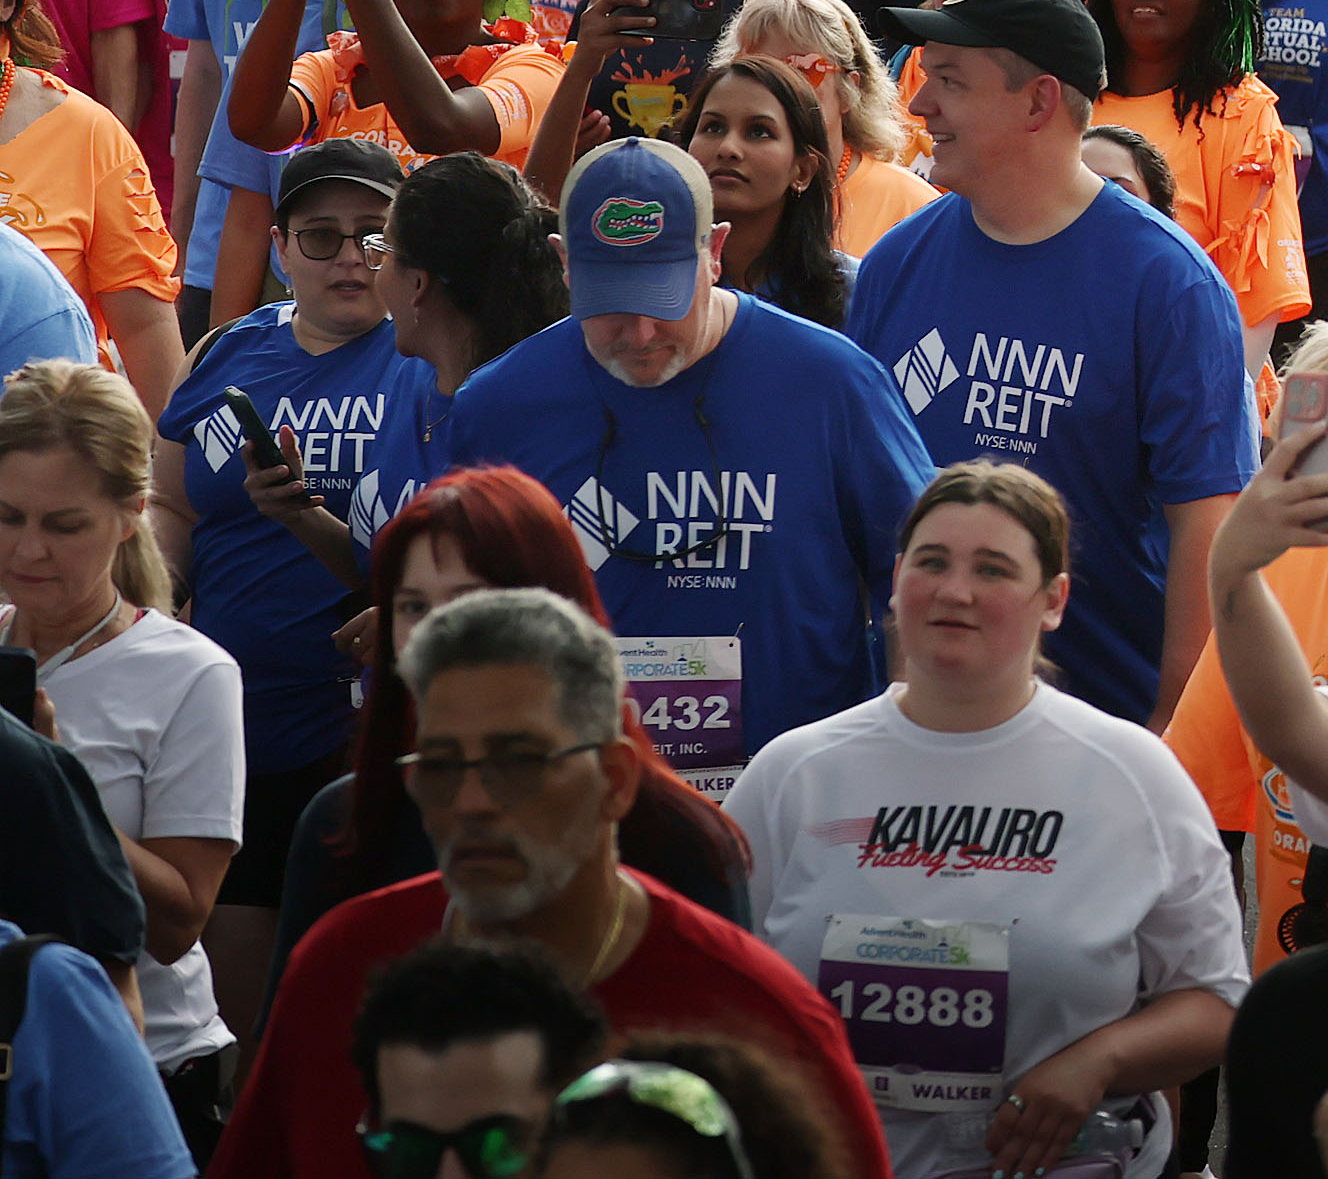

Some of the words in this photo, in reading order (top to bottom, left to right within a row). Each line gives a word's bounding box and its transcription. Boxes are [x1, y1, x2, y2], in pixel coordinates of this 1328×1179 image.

[1266, 18, 1327, 38] ORIDA
[1263, 30, 1323, 54] RTUAL
[1262, 46, 1320, 68] HOOL
[967, 332, 1085, 398] NNN
[269, 393, 386, 431] NNN
[974, 432, 1039, 456] NYSE:NNN
[302, 476, 352, 491] SE:NNN
[646, 470, 776, 521] NNN
[666, 574, 738, 591] NYSE:NNN
[622, 660, 707, 679] RPORATE5k
[653, 744, 678, 760] EIT,
[682, 743, 708, 757] INC.
[687, 775, 734, 793] ALKER
[857, 842, 946, 877] Fueling
[955, 844, 1057, 875] Success
[831, 980, 994, 1028] 12888
[911, 1082, 992, 1102] WALKER
